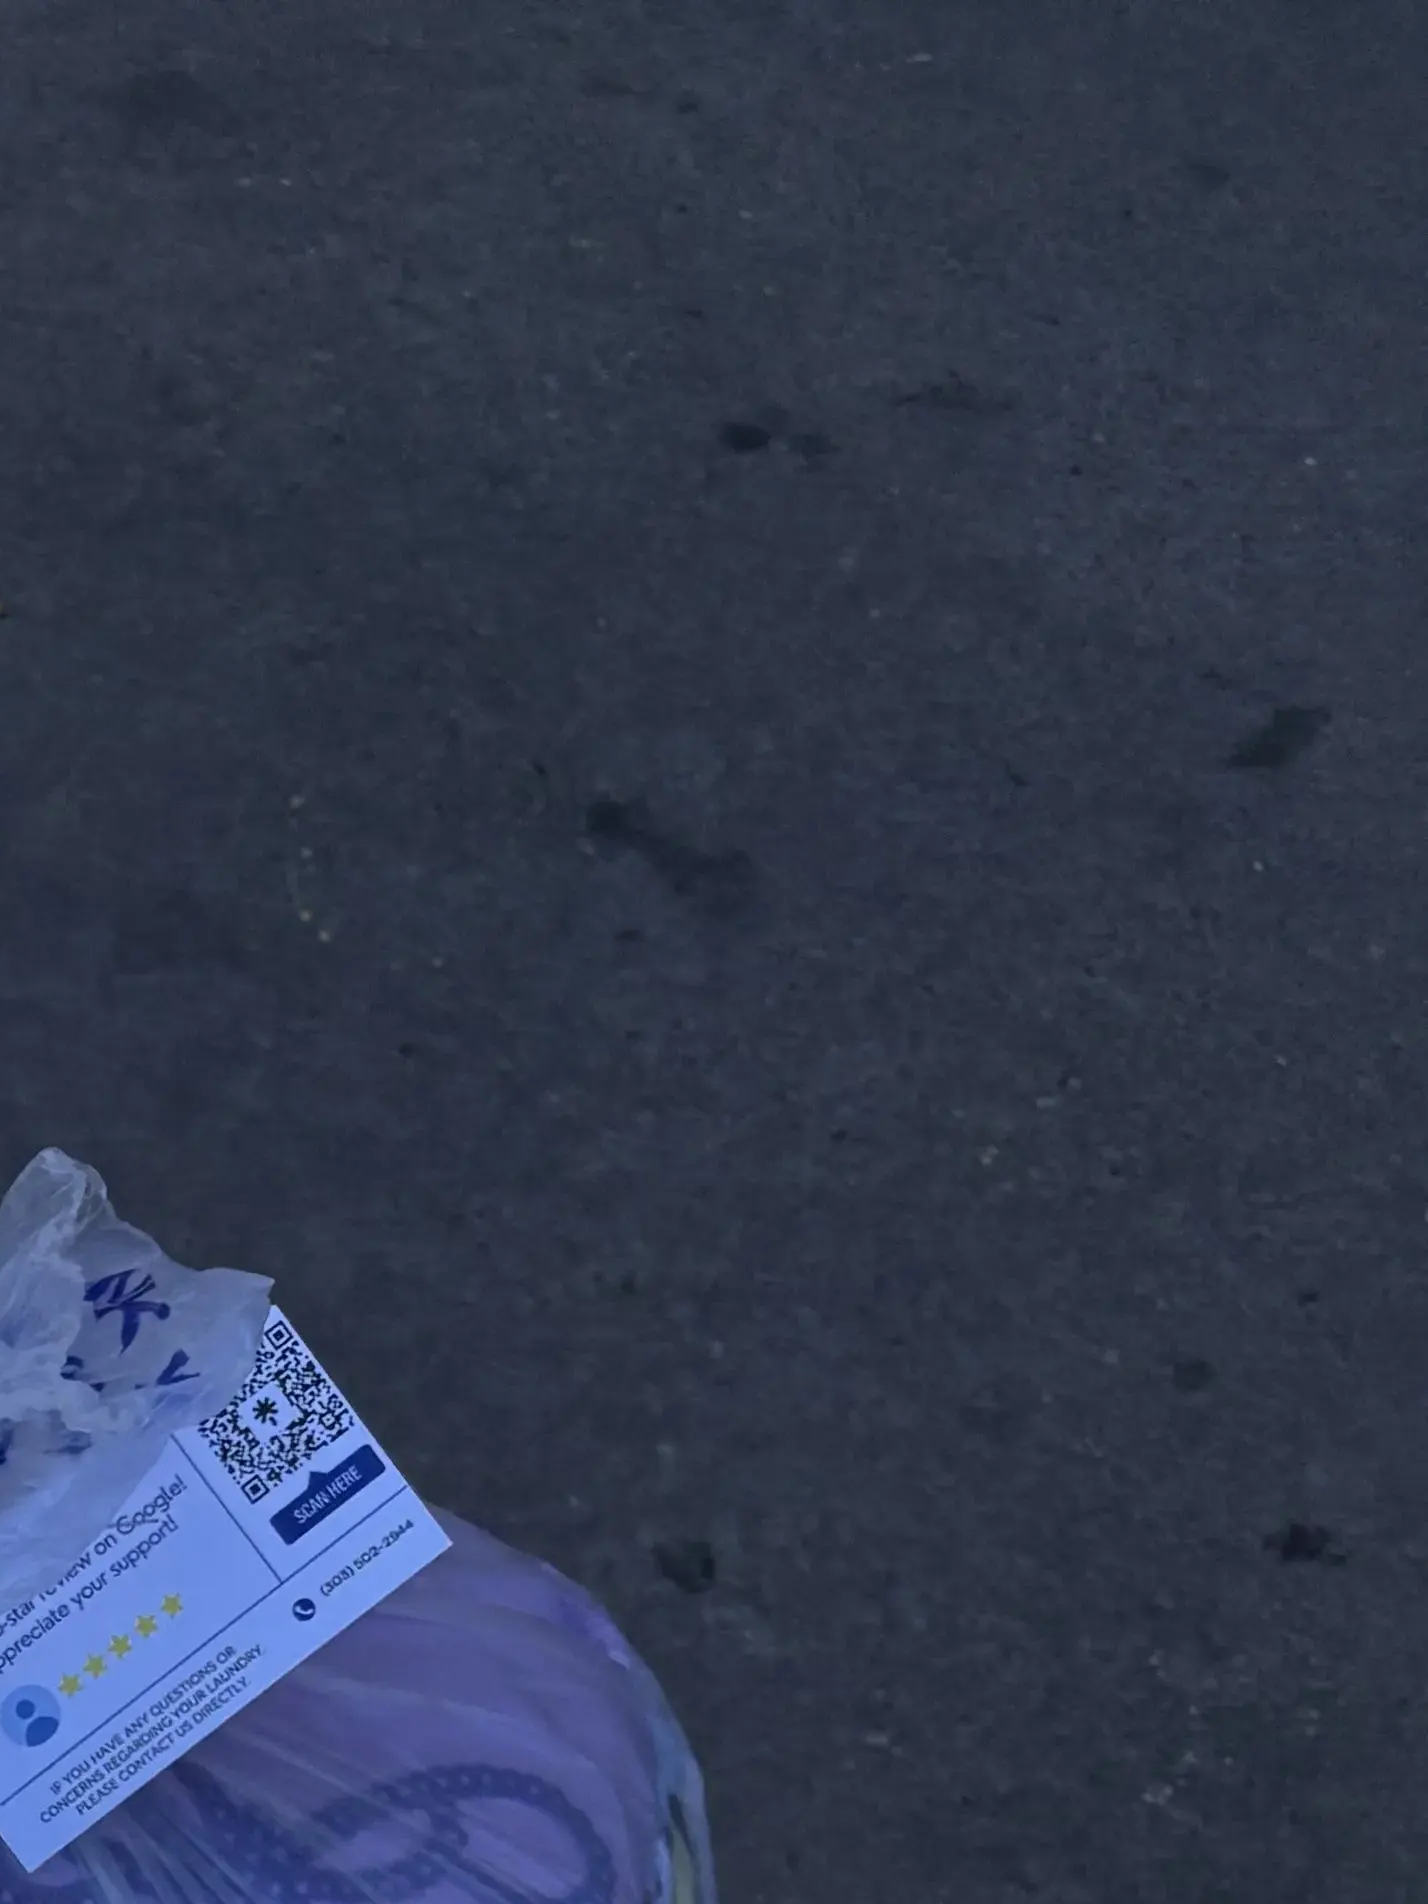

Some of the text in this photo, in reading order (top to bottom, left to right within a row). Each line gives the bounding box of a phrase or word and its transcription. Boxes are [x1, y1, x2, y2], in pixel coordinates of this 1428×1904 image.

[92, 1533, 118, 1556] on
[114, 1473, 188, 1536] Google!
[292, 1464, 362, 1524] SCAN HERE
[68, 1571, 108, 1611] your
[108, 1512, 179, 1578] support!
[39, 1768, 106, 1823] CONCERNS
[101, 1714, 173, 1774] REGARDING
[169, 1688, 208, 1719] YOUR
[49, 1645, 236, 1795] IF YOU HAVE ANY QUESTIONS OR
[74, 1777, 119, 1816] PLEASE
[117, 1731, 175, 1782] CONTACT
[173, 1718, 194, 1738] US
